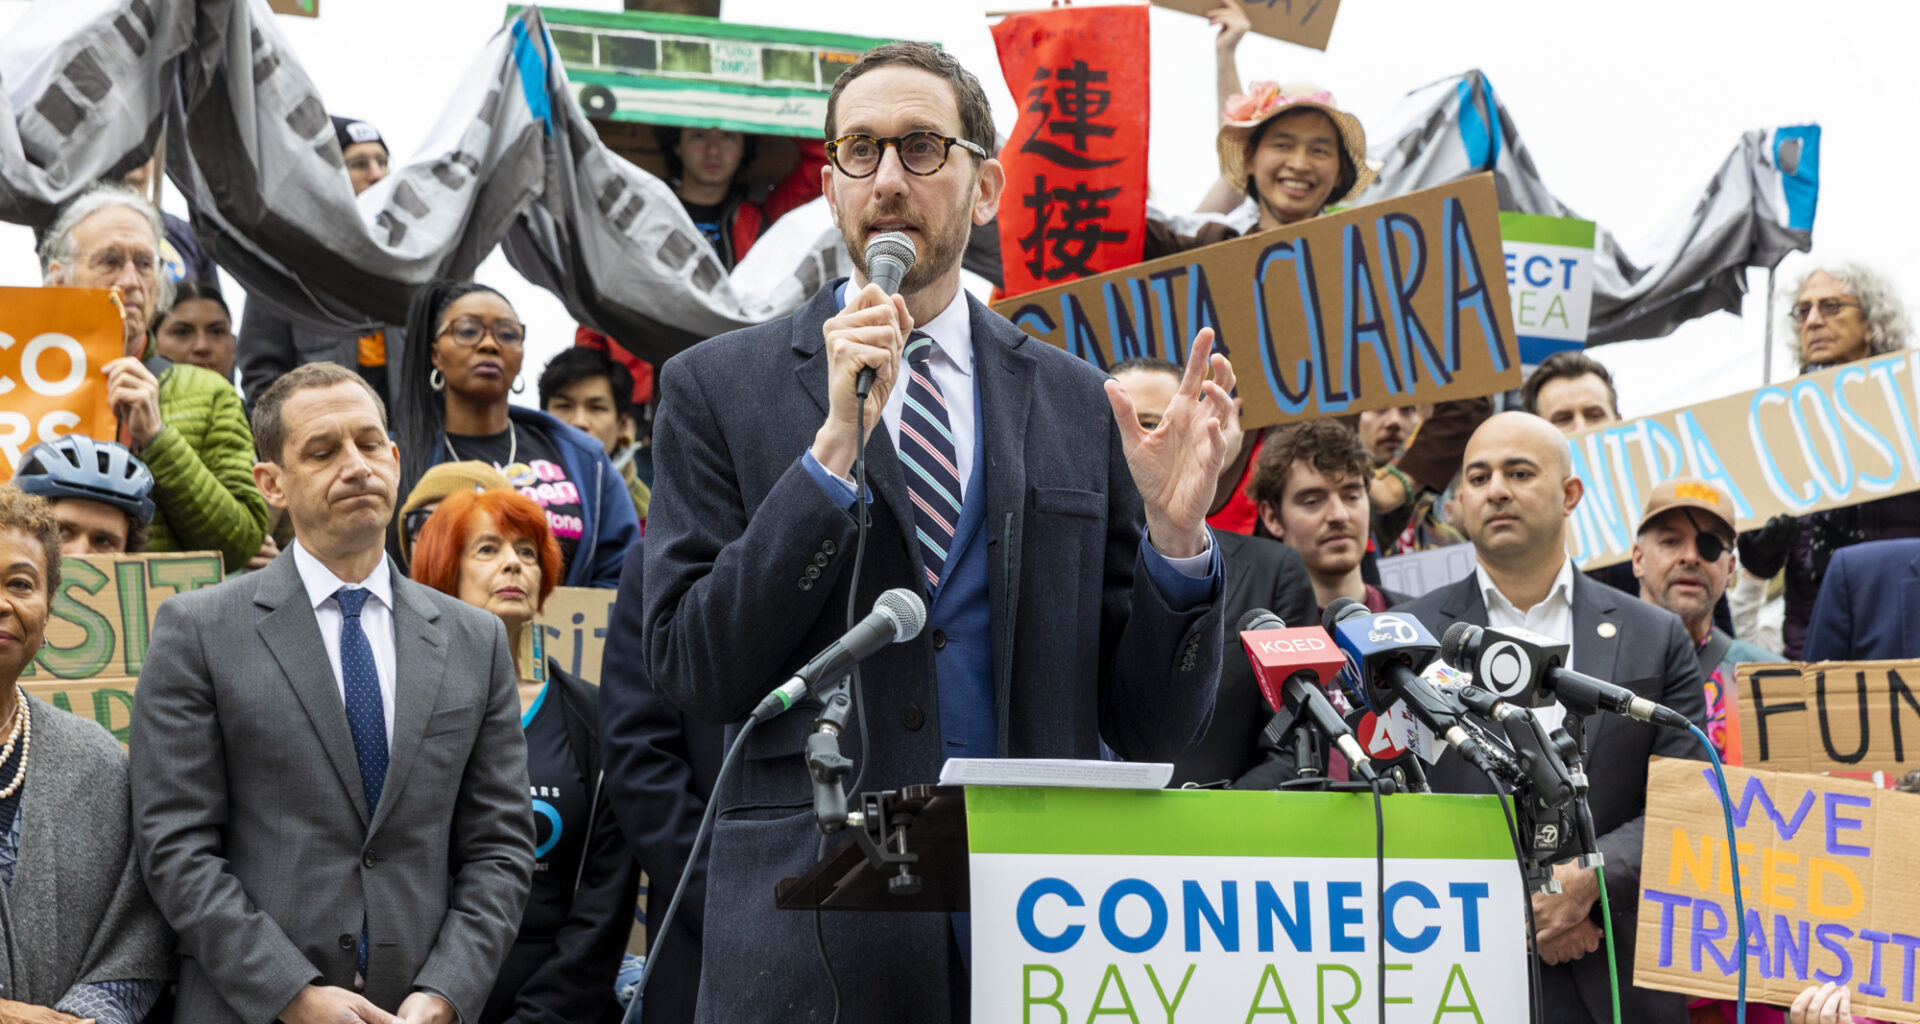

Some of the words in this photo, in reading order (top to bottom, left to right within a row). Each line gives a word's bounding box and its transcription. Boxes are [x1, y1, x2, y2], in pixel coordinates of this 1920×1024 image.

[1019, 59, 1129, 281] 連接
[1253, 197, 1511, 415] CLARA
[1260, 638, 1326, 655] KQED
[1702, 767, 1871, 858] WE
[1016, 876, 1490, 954] CONNECT
[1668, 827, 1865, 920] NEED
[1643, 888, 1920, 1003] TRANSIT
[1021, 962, 1197, 1024] BAY
